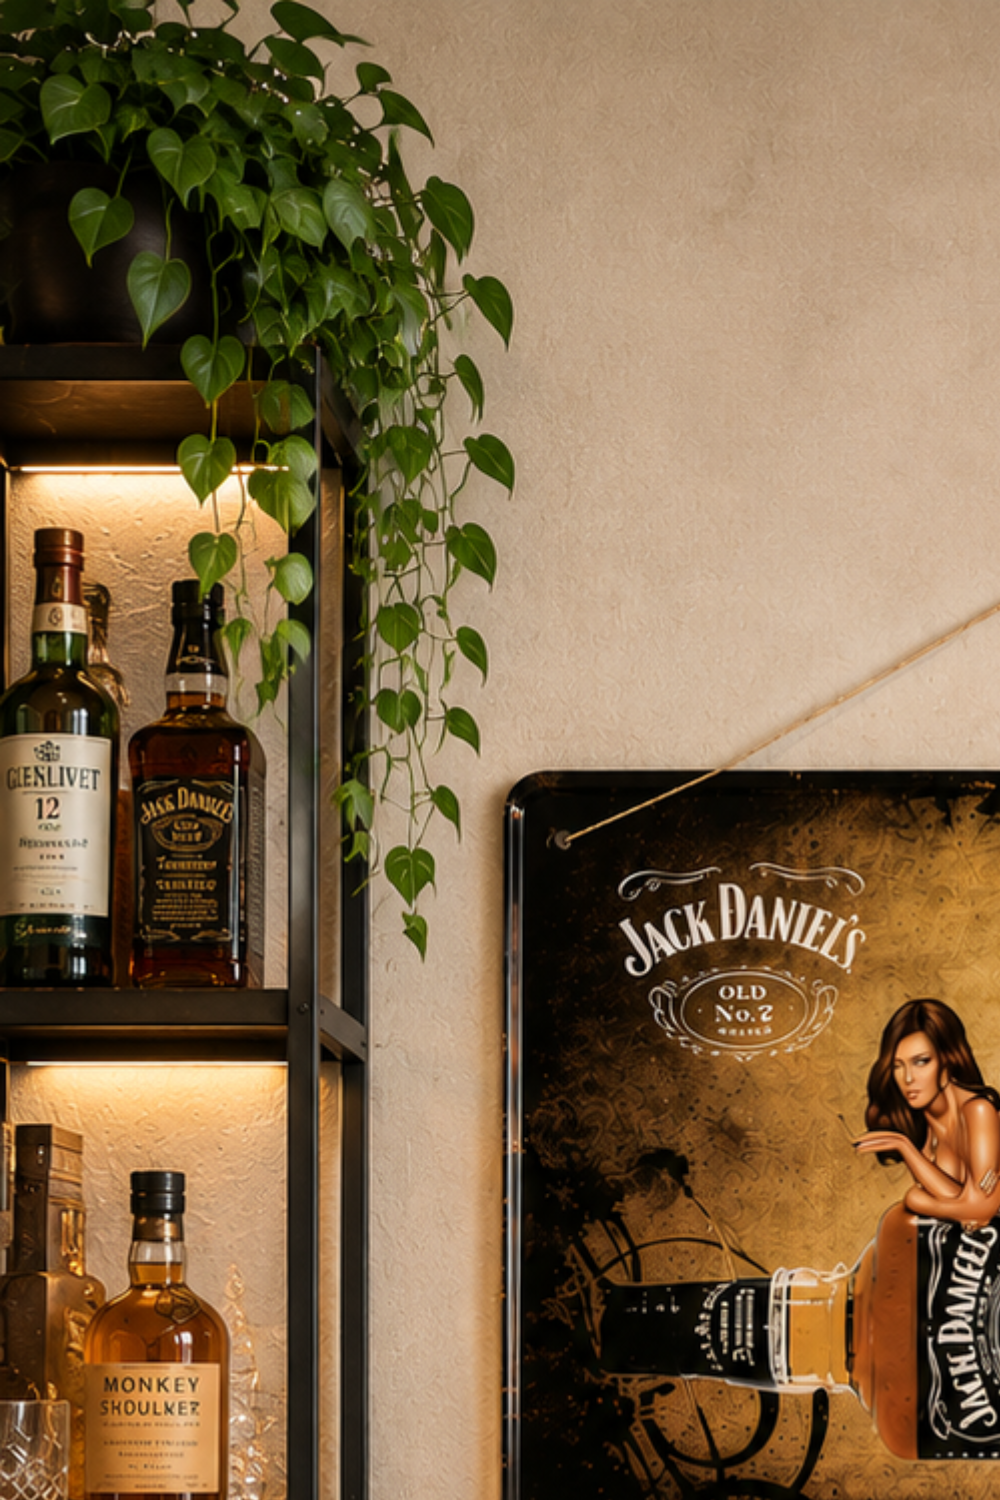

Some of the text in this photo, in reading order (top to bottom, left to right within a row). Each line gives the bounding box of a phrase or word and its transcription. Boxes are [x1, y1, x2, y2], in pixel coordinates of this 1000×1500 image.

[35, 797, 60, 820] 12
[619, 883, 866, 977] JACK DANIEL'S
[719, 985, 767, 1000] OLD
[104, 1376, 199, 1393] MONKEY
